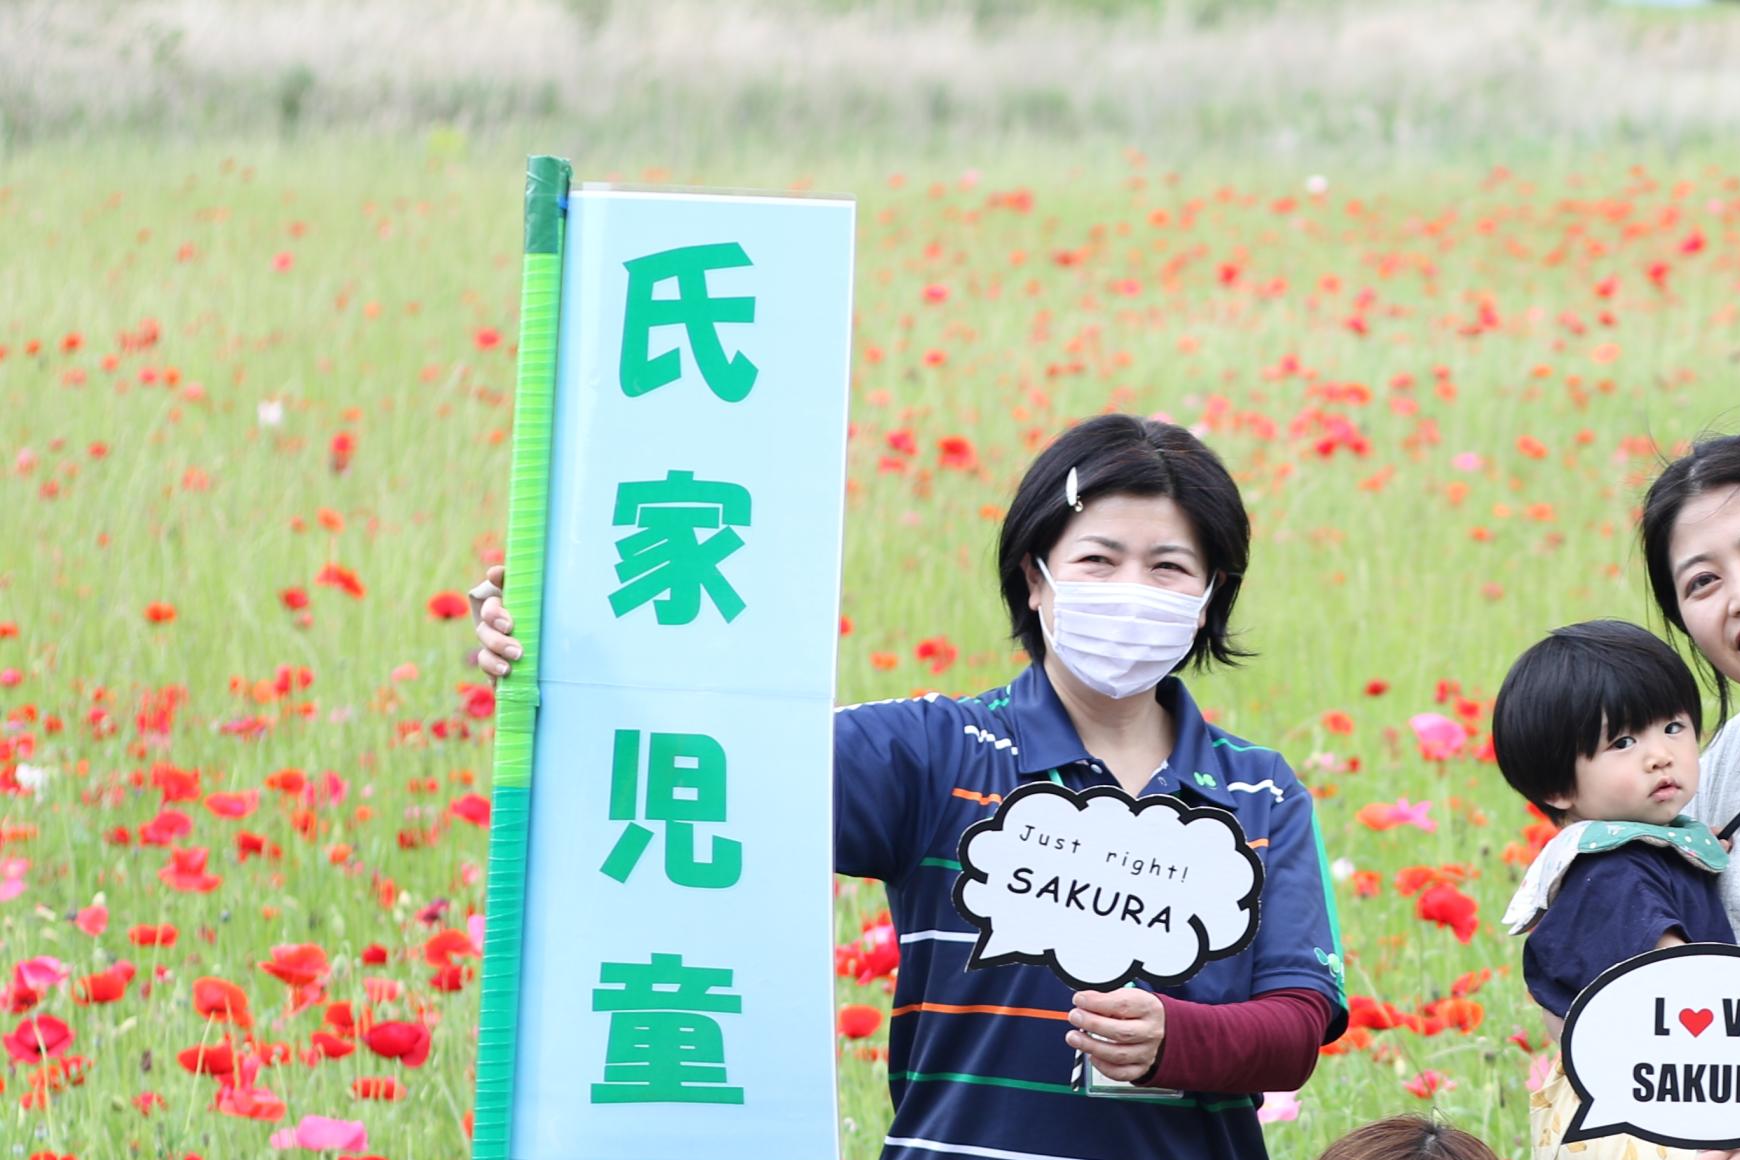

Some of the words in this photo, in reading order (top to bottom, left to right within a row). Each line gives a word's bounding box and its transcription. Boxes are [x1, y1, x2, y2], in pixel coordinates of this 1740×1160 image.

[1018, 824, 1083, 854] Just
[1106, 850, 1189, 884] right!
[1006, 867, 1172, 933] SAKURA
